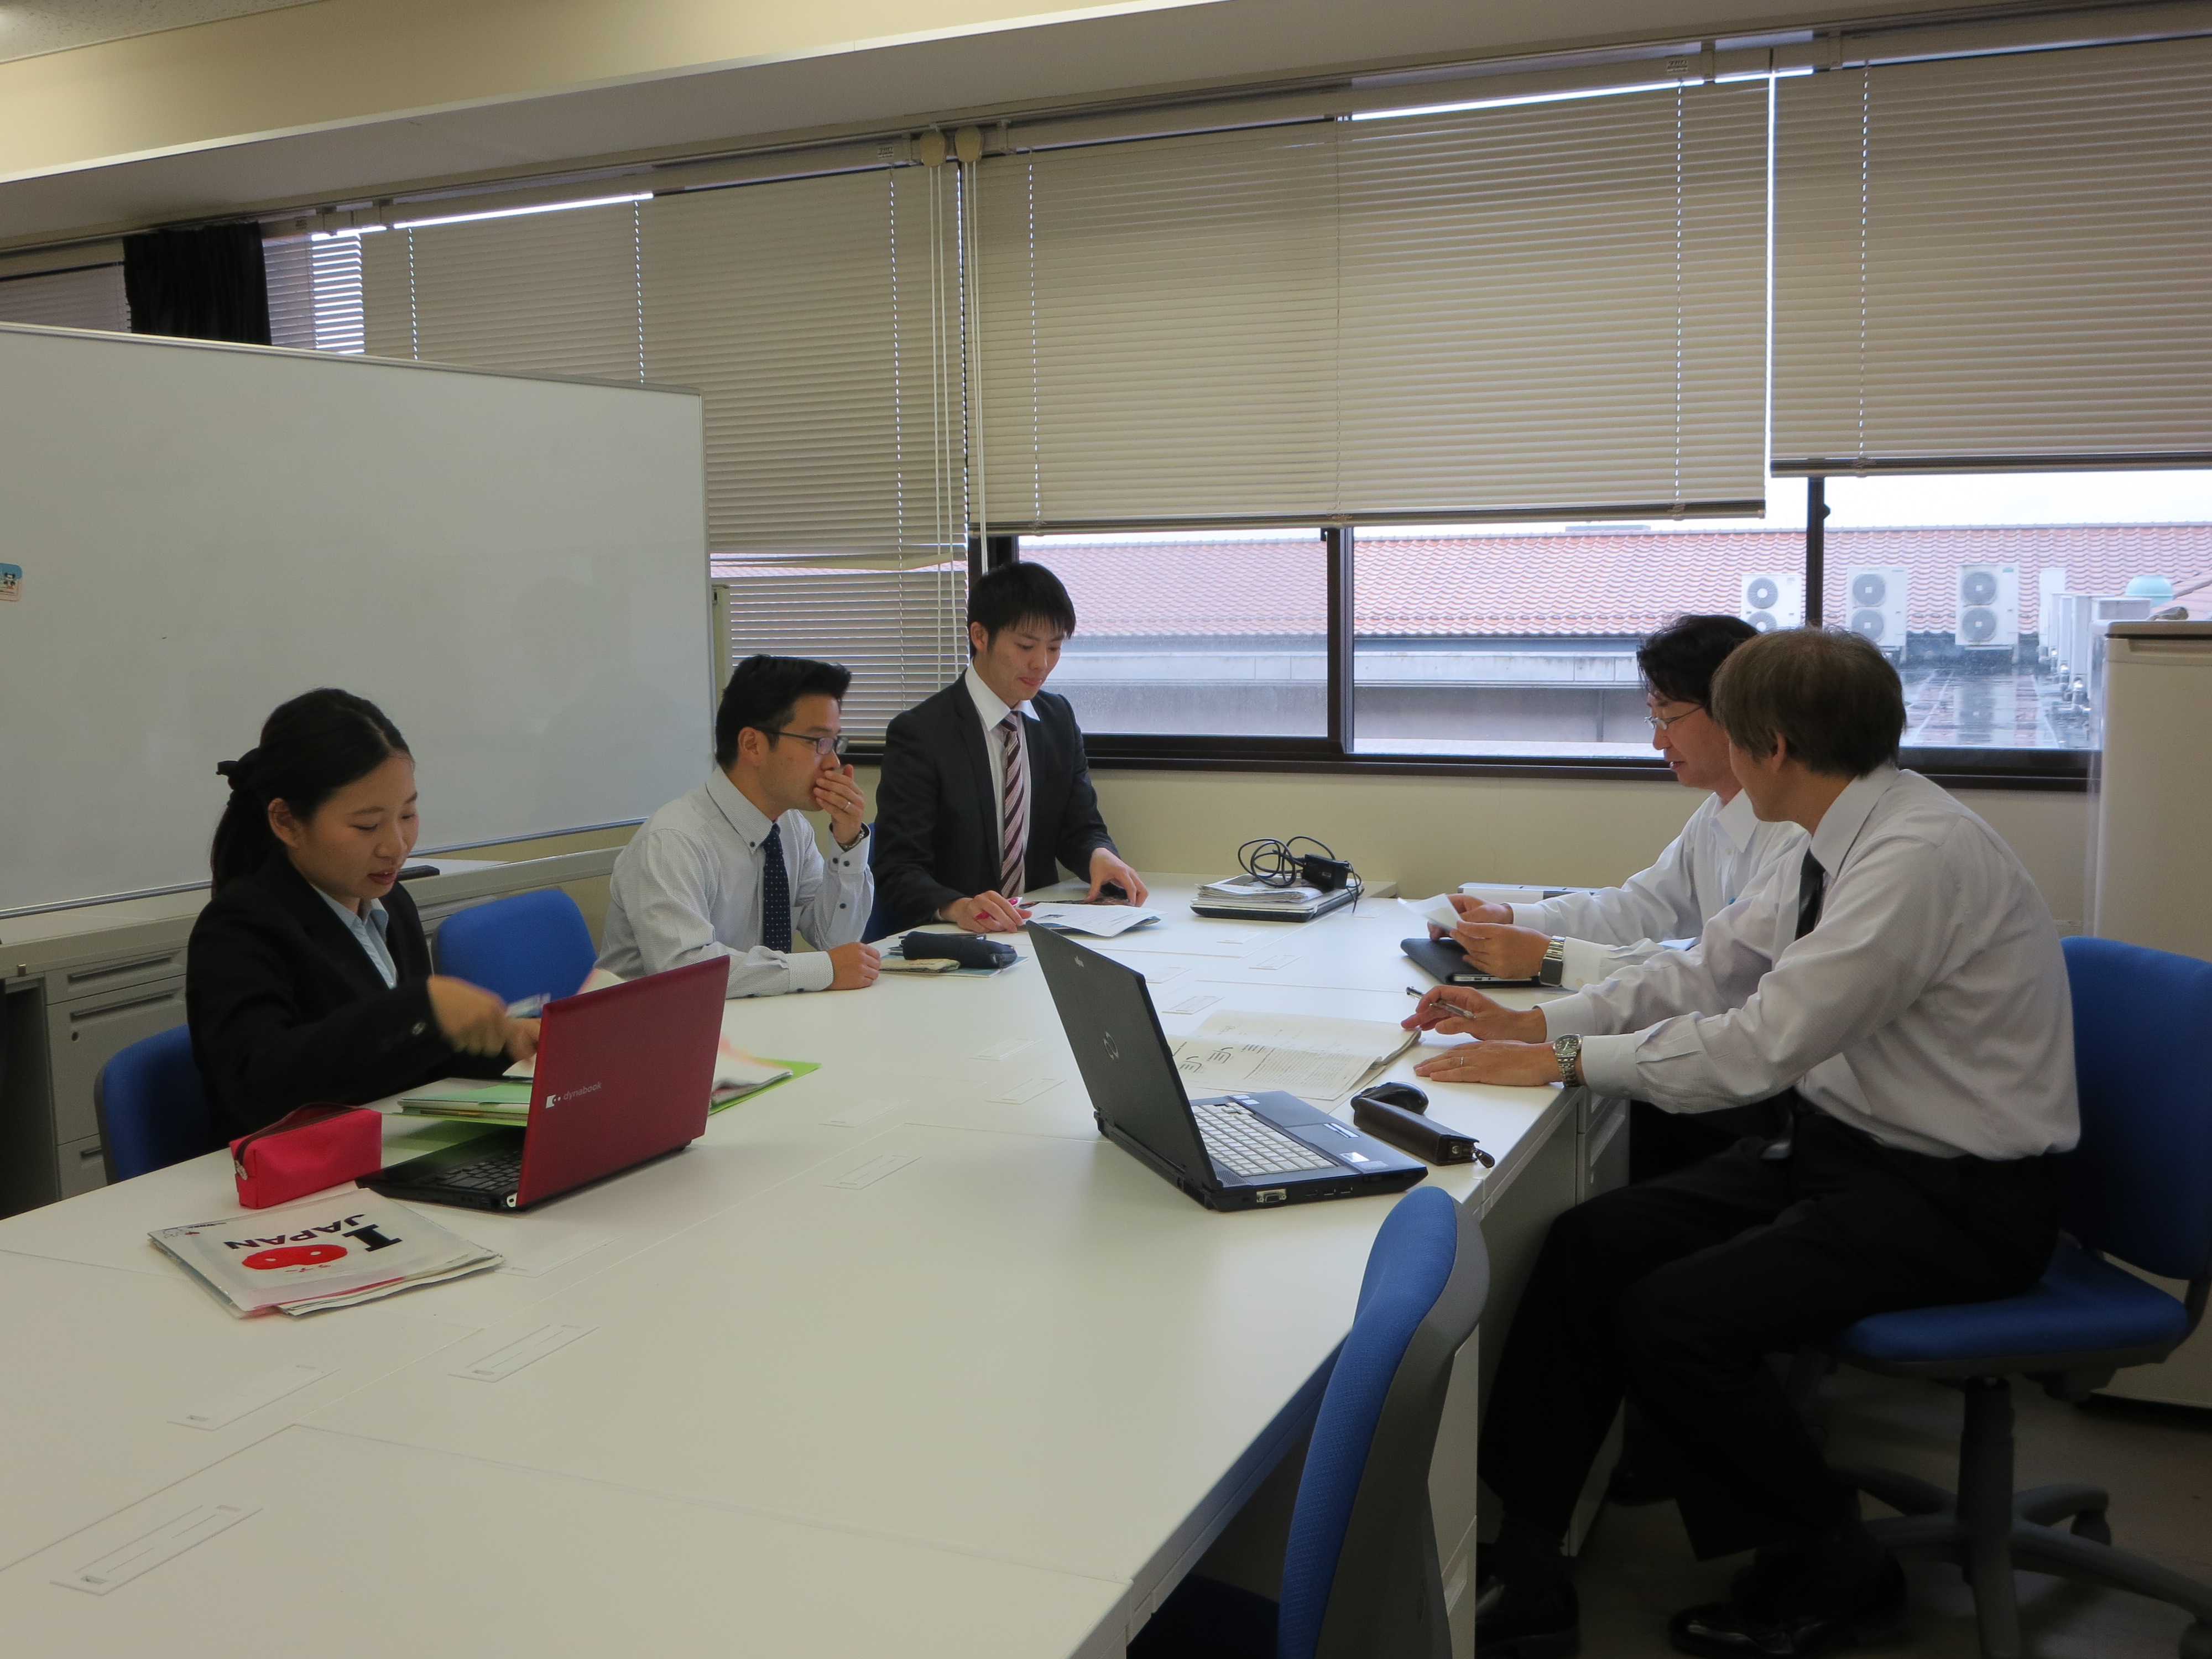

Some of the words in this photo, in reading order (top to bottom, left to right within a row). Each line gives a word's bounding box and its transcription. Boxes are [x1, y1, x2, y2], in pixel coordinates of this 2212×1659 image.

[564, 1082, 602, 1100] dynabook
[223, 1214, 366, 1249] JAPAN
[342, 1223, 403, 1252] I
